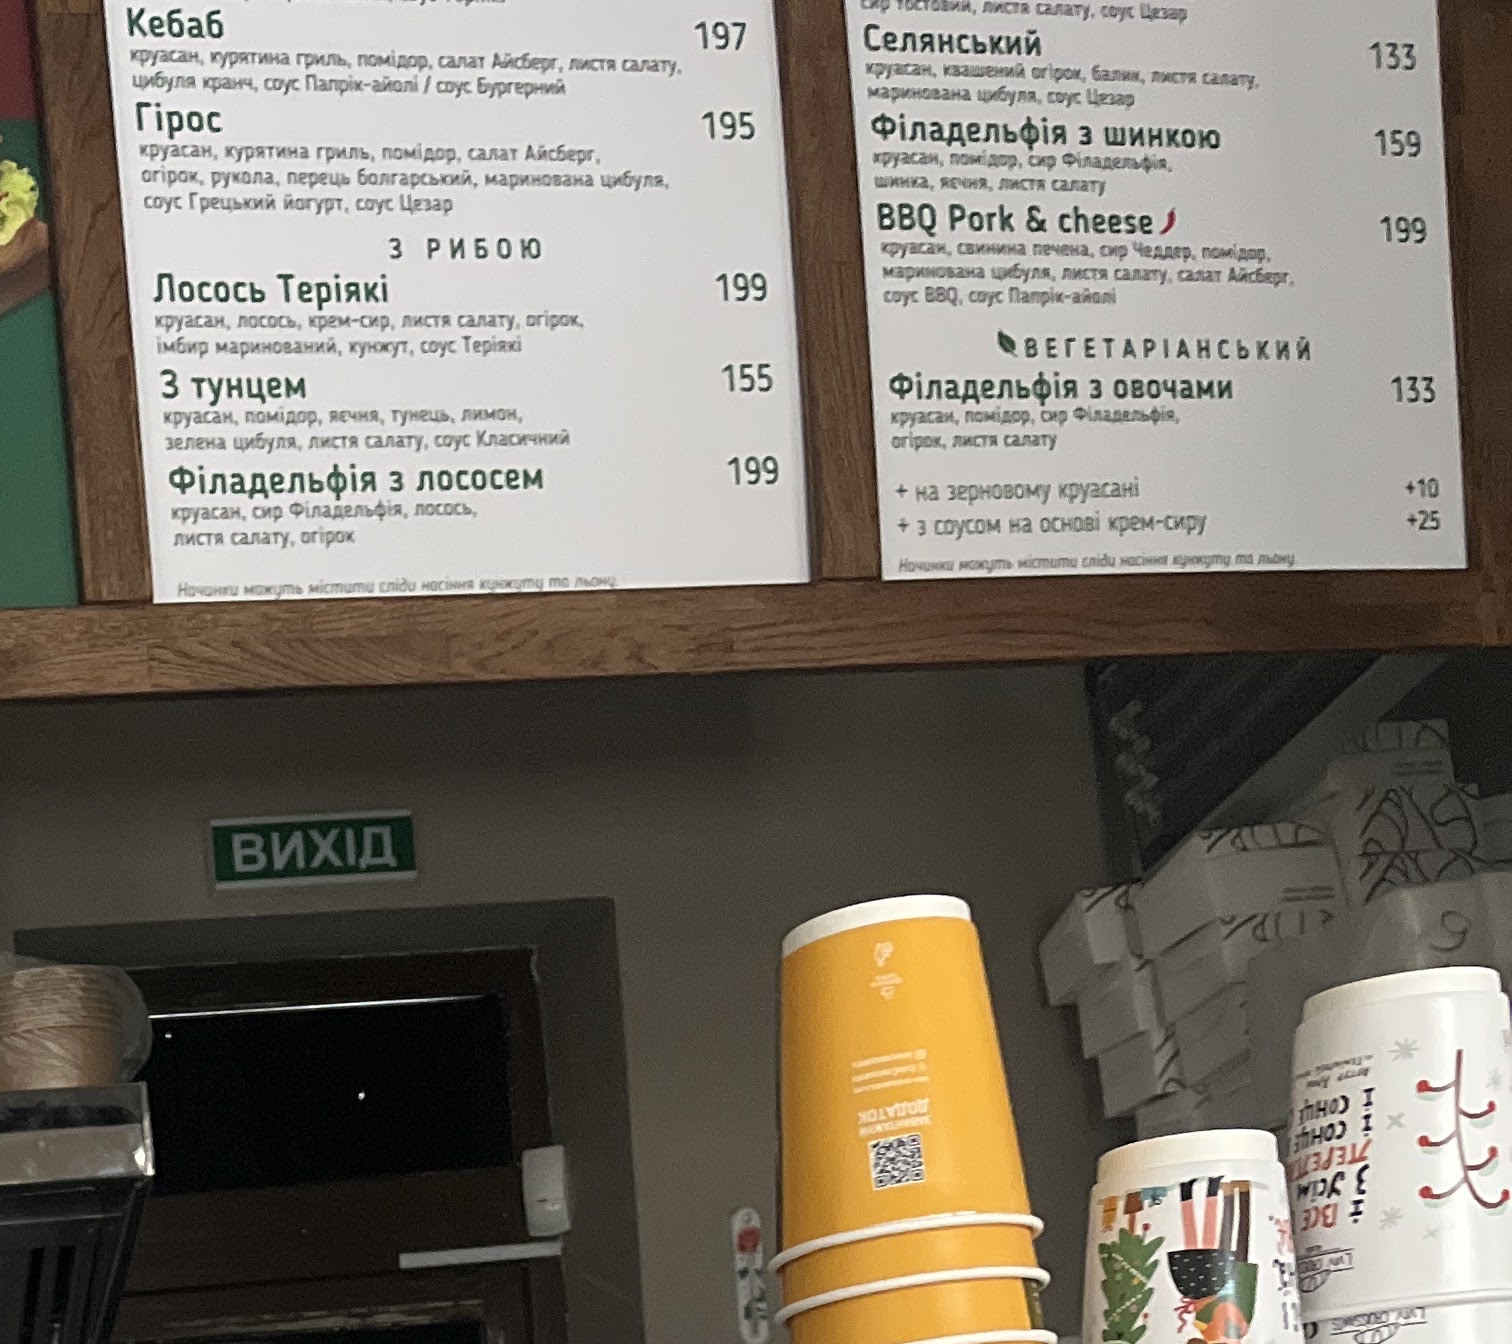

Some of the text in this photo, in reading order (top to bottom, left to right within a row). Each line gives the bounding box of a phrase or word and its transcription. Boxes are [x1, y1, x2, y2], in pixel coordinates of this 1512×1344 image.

[127, 8, 746, 50] Кебаб 197
[864, 24, 1416, 70] Селянський 133
[136, 102, 755, 140] Гірос 195
[871, 113, 1421, 157] Філадельфія з шинкою 159
[144, 192, 453, 216] соус Грецький йогурт, соус Цезар
[877, 203, 1427, 243] BBQ Pork & cheese 199
[389, 238, 541, 259] З РИБОЮ
[154, 273, 767, 311] Лосось Теріякі 199
[155, 310, 583, 333] круасан, лосось, крем-сир, листя салату, огірок,
[1024, 336, 1310, 361] ВЕГЕТАРІАНСЬКИЙ
[160, 363, 772, 406] З тунцем 155
[890, 372, 1435, 407] Філадельфія з овочами 133
[169, 456, 778, 501] Філадельфія з лососем 199
[915, 485, 940, 501] на
[947, 483, 1051, 505] зерновому
[1058, 476, 1139, 504] круасані
[1405, 478, 1439, 498] +10
[917, 520, 927, 536] з
[934, 519, 1001, 540] соусом
[1009, 517, 1032, 533] на
[1040, 510, 1100, 533] основі
[1108, 515, 1206, 537] крем-сиру
[1407, 510, 1440, 530] +25
[230, 824, 399, 874] ВИХІД
